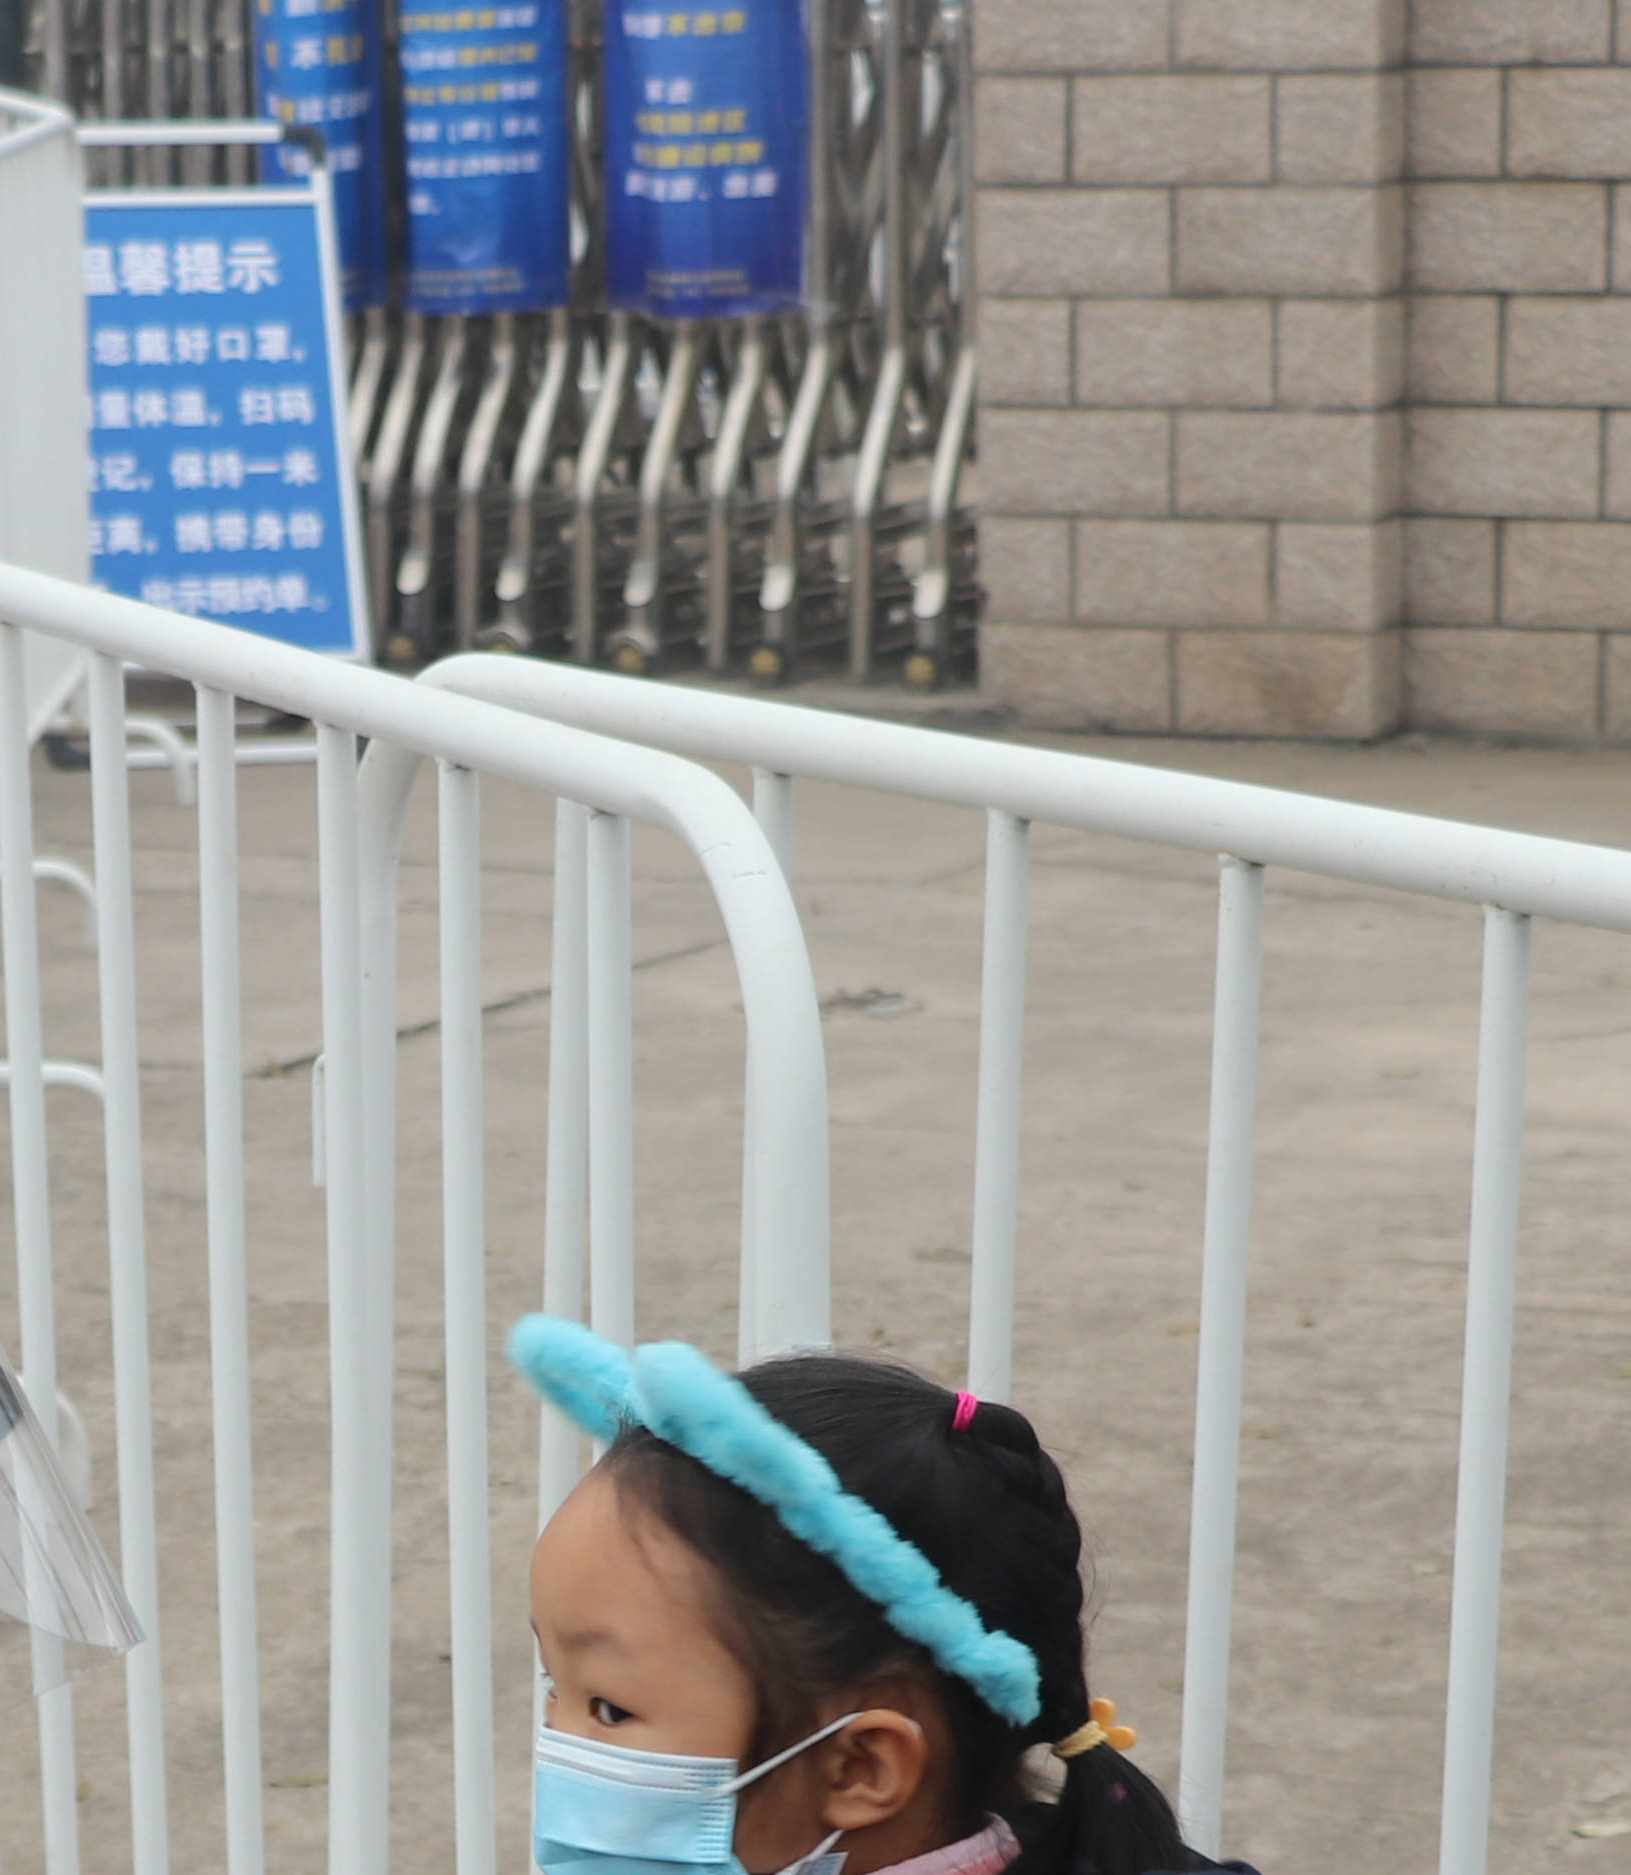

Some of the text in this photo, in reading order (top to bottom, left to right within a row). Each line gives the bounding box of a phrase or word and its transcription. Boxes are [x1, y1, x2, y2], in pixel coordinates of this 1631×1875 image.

[84, 241, 281, 295] 温馨提示
[86, 387, 314, 428] 量体温，扫码
